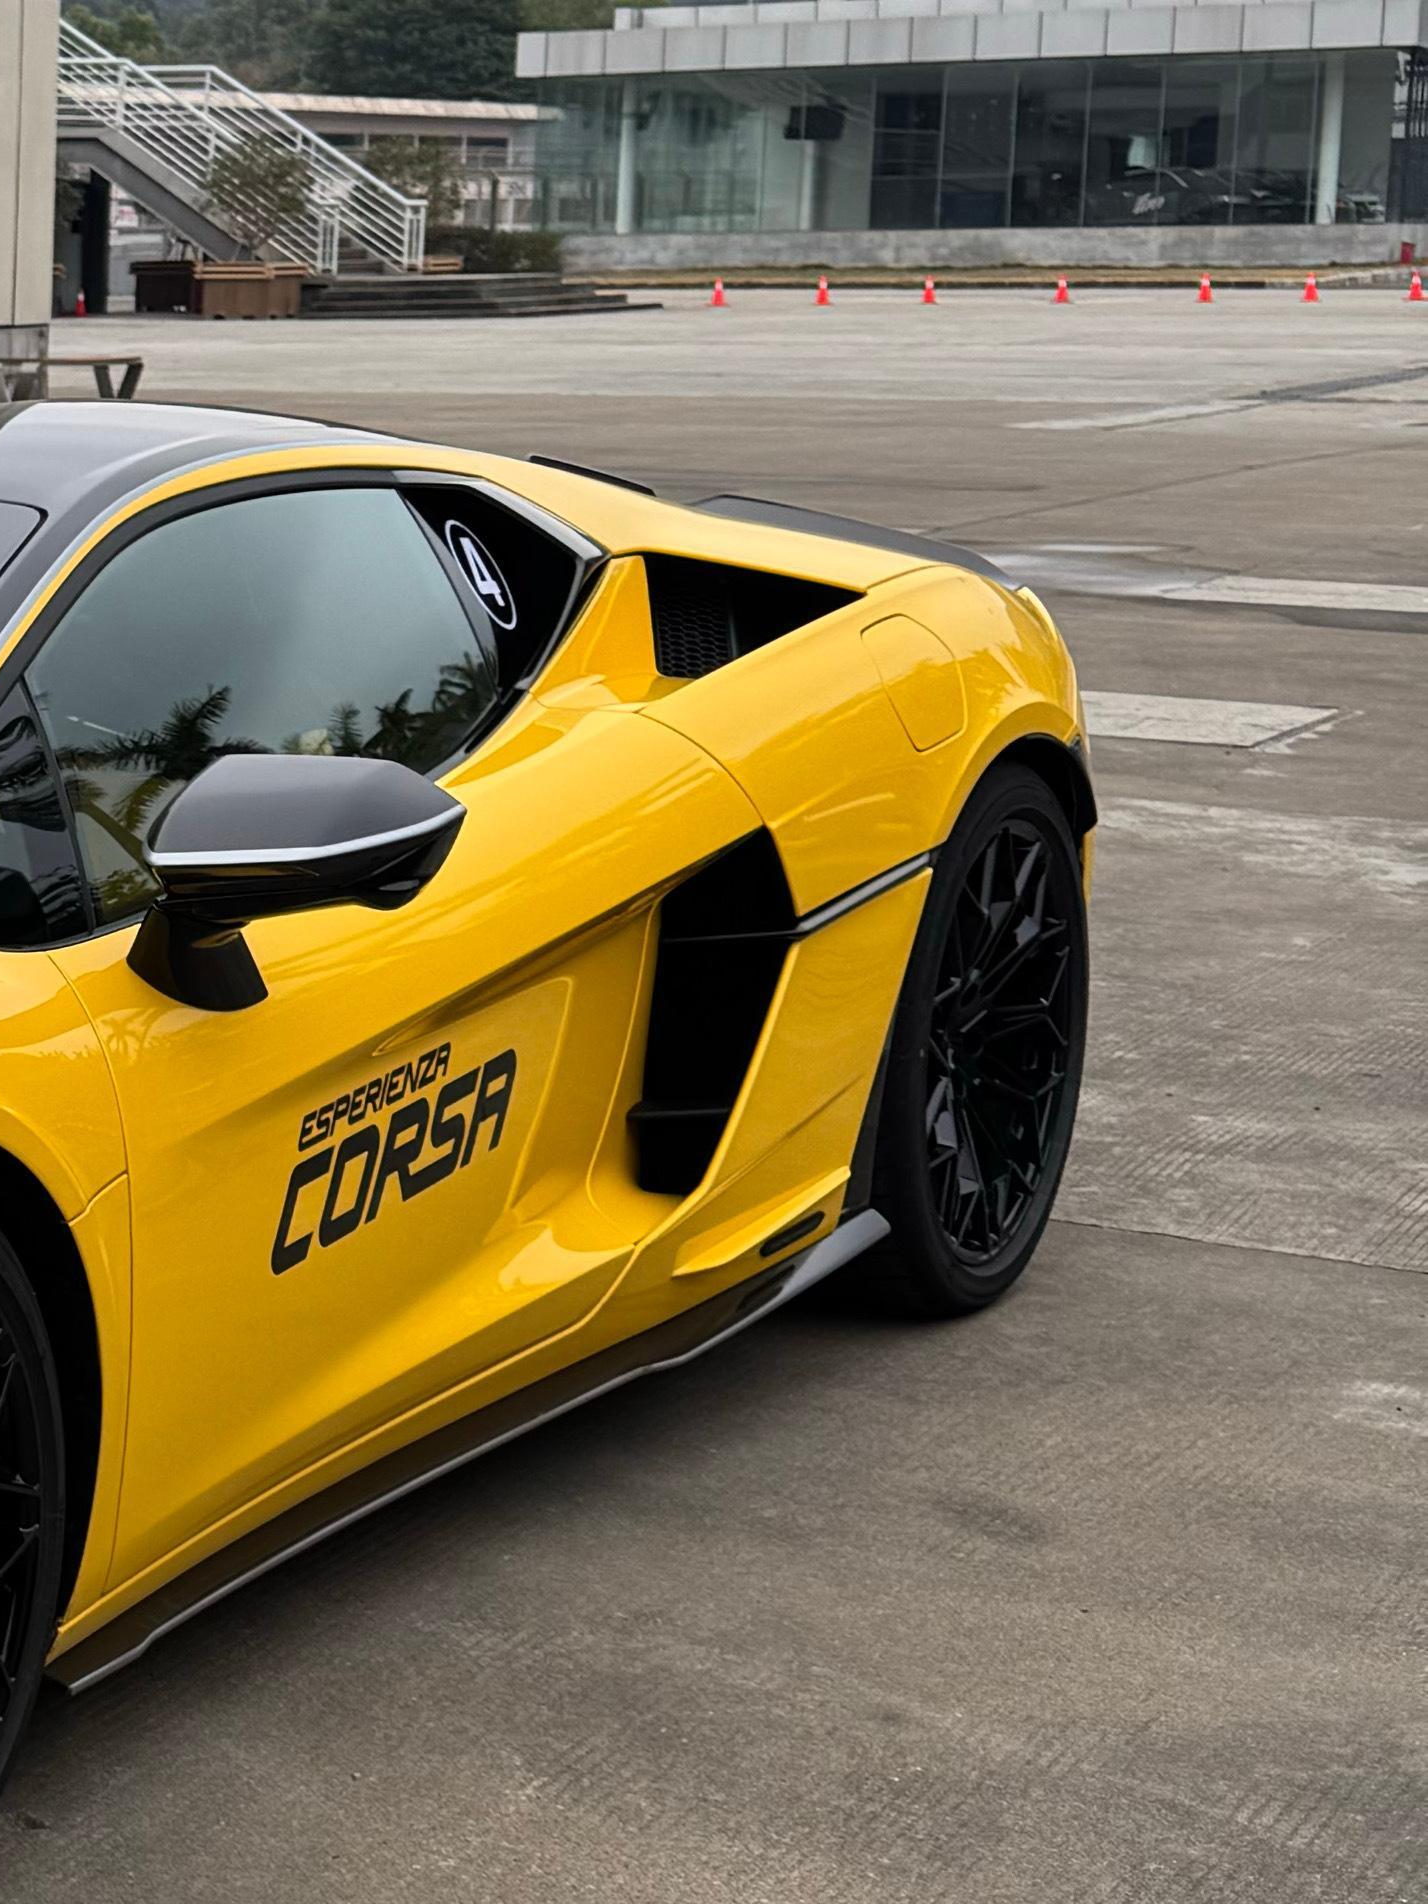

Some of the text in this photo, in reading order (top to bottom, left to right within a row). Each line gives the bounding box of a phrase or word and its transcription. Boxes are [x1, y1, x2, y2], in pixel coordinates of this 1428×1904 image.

[459, 537, 505, 607] 4
[298, 1041, 451, 1152] ESPERIENZA
[271, 1048, 517, 1276] CORSA
